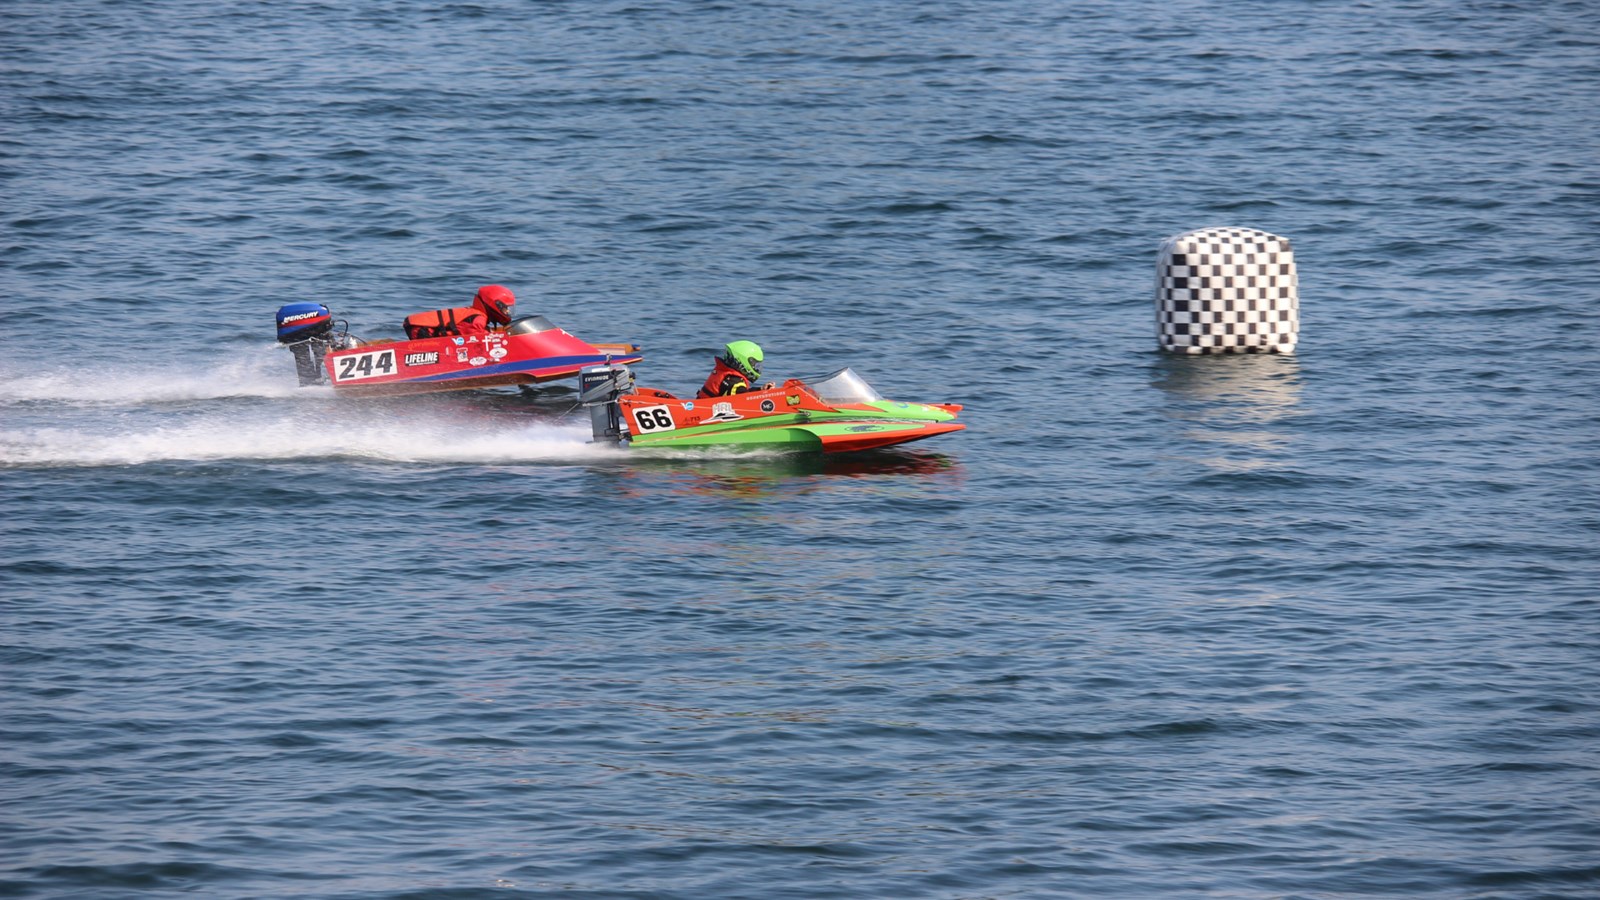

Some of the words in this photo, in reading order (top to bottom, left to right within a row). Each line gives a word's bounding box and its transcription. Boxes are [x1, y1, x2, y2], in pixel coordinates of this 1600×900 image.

[282, 311, 319, 325] MERCURY
[339, 352, 393, 380] 244
[405, 352, 438, 364] LIFELINE
[636, 409, 672, 430] 66
